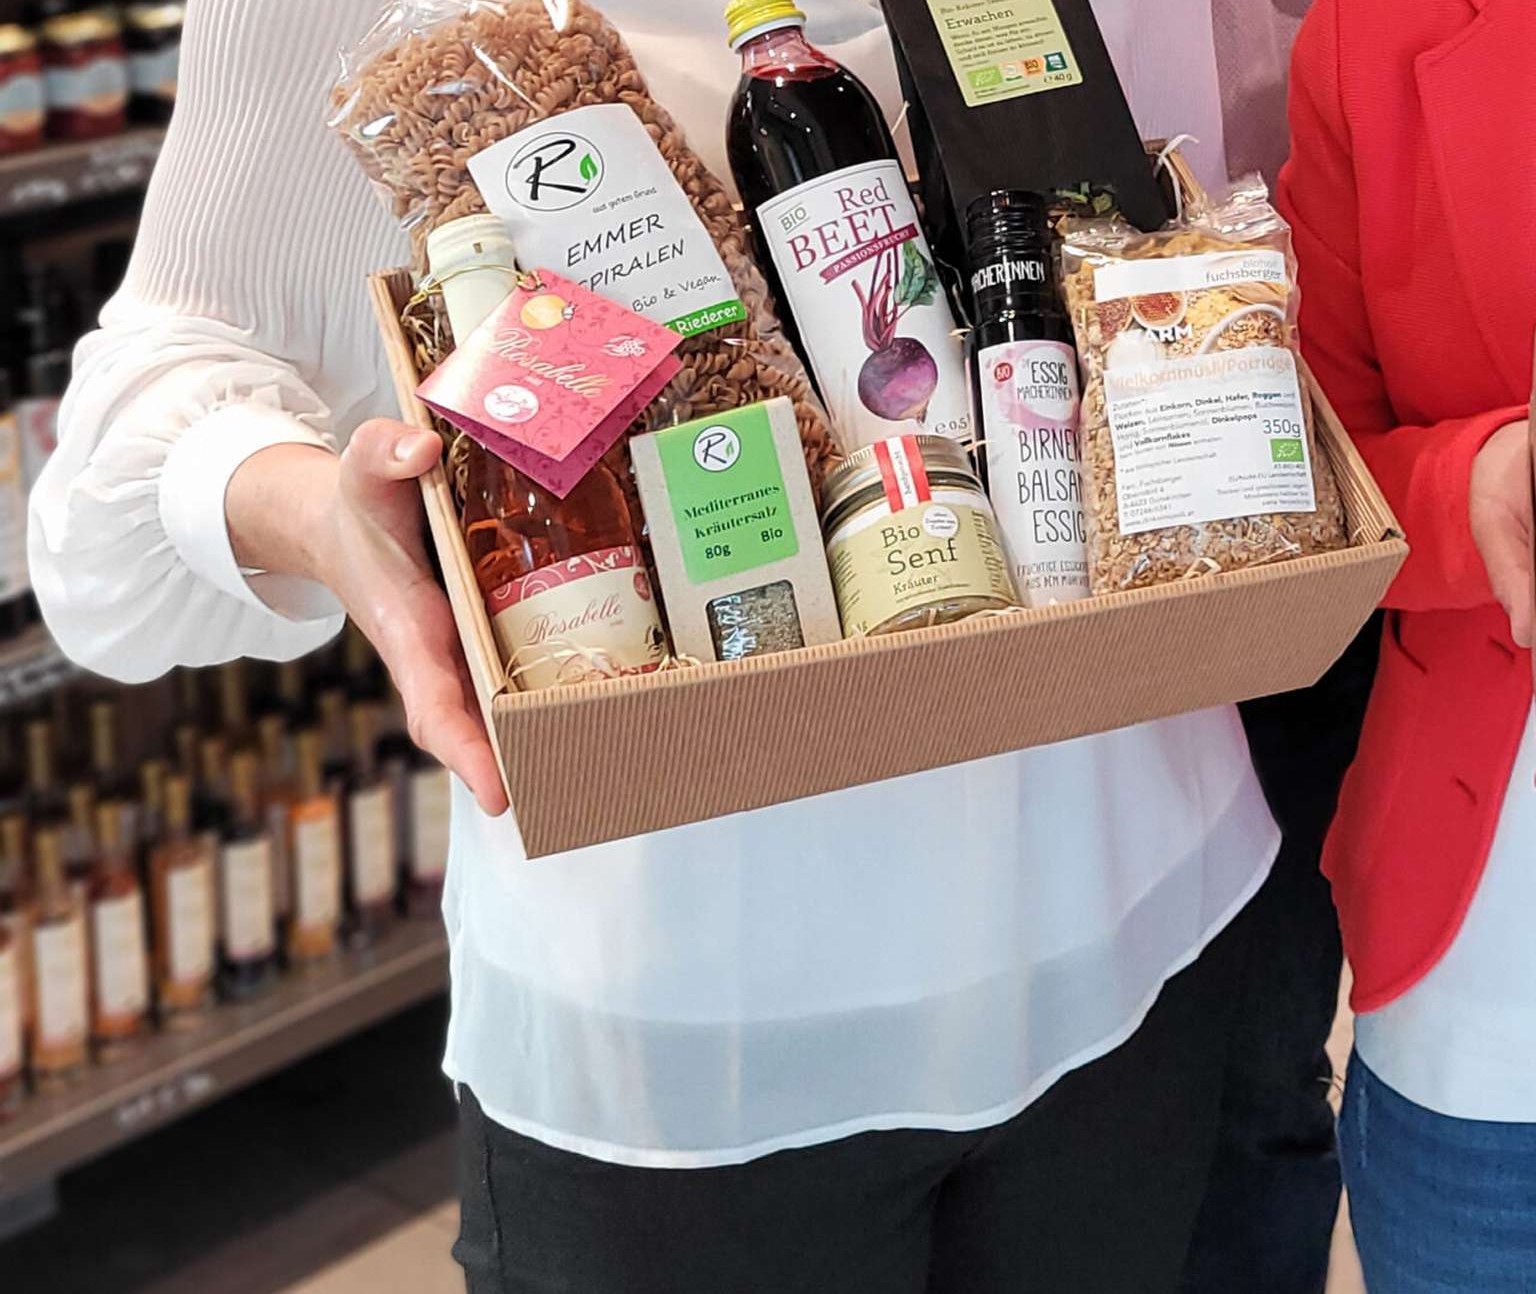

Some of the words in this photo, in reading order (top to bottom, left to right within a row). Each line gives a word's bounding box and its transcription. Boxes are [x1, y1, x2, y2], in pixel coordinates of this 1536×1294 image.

[945, 9, 1014, 30] Erwachen
[512, 138, 588, 201] R
[834, 177, 891, 214] Red
[780, 207, 807, 232] BIO
[566, 212, 665, 268] EMMER
[786, 203, 897, 273] BEET
[833, 229, 911, 274] PASSIONSFRUCHT
[1205, 267, 1282, 283] fuchsberger
[632, 295, 658, 313] Bio
[663, 287, 678, 300] &
[678, 273, 722, 292] Vegan
[675, 305, 738, 335] Riederer
[488, 328, 614, 399] Rosabelle
[1031, 360, 1068, 386] ESSIG
[1211, 413, 1258, 424] Dinkelpops
[1263, 418, 1301, 438] 350g
[683, 485, 780, 521] Mediterranes
[694, 506, 778, 539] Kräutersalz
[880, 525, 921, 549] Bio
[1032, 509, 1087, 544] ESSIG
[704, 544, 731, 559] 80g
[760, 528, 783, 543] Bio
[886, 537, 959, 576] Senf
[892, 574, 939, 595] Kräuter
[520, 592, 624, 646] Rosabelle
